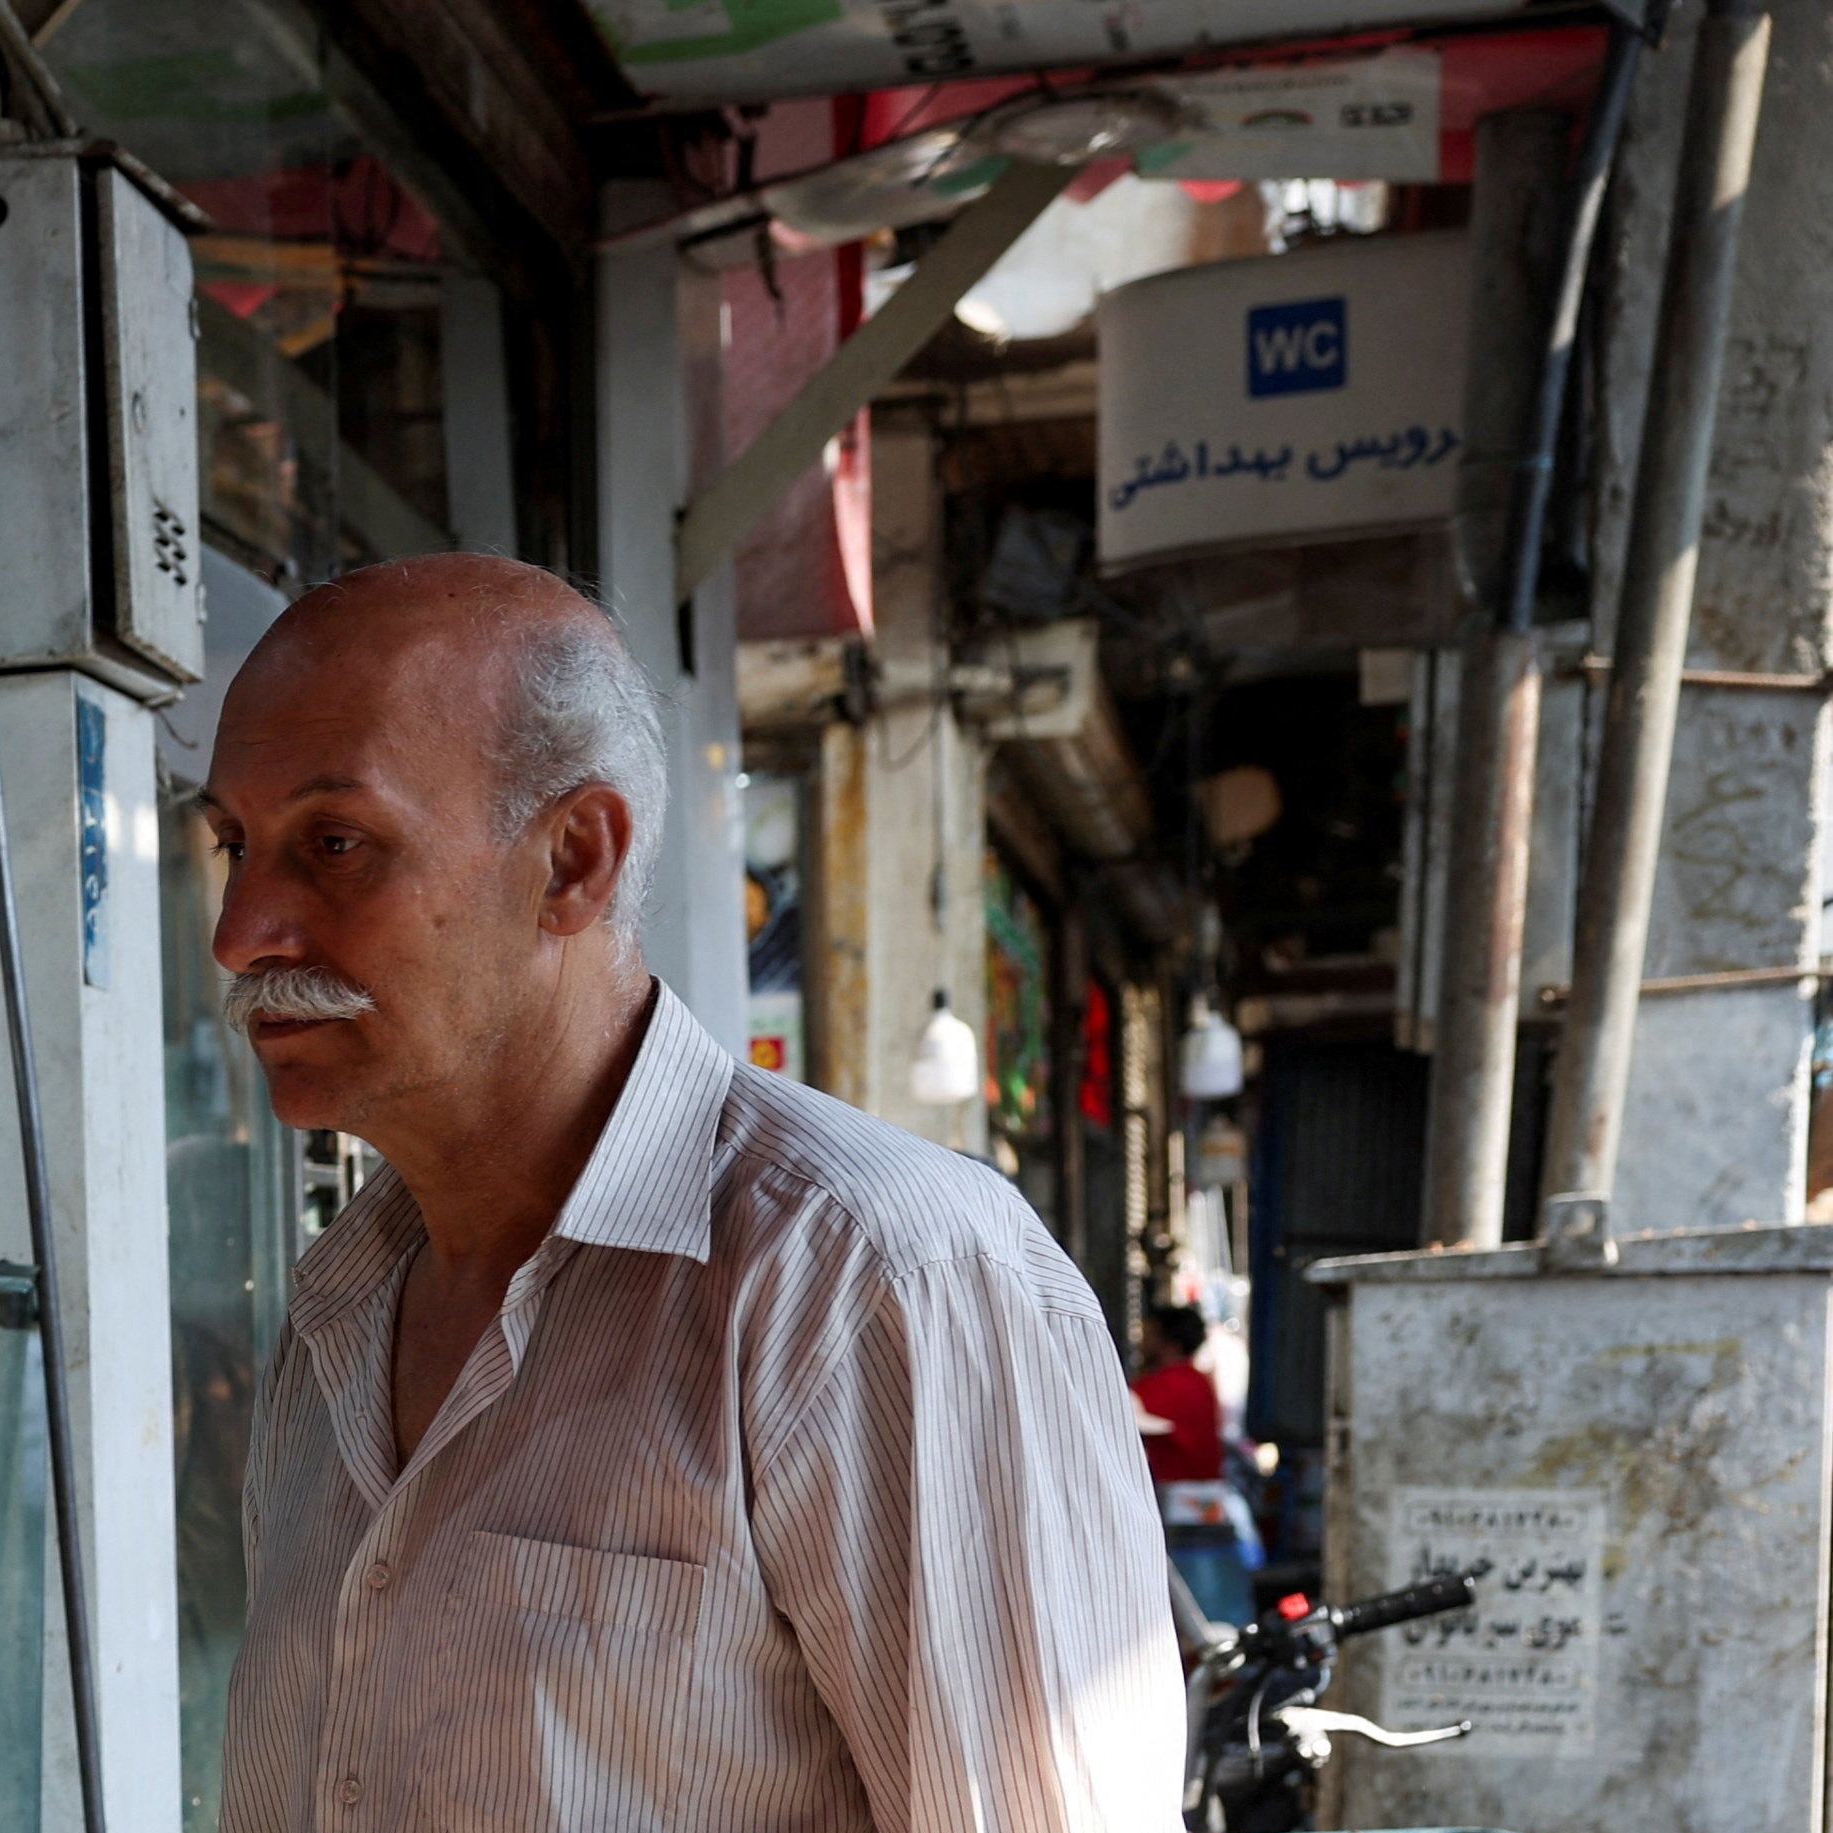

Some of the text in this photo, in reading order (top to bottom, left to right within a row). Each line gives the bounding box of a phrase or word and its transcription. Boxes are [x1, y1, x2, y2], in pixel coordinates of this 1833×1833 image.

[1255, 320, 1338, 375] WC
[1110, 424, 1464, 512] رویس بهداشتی
